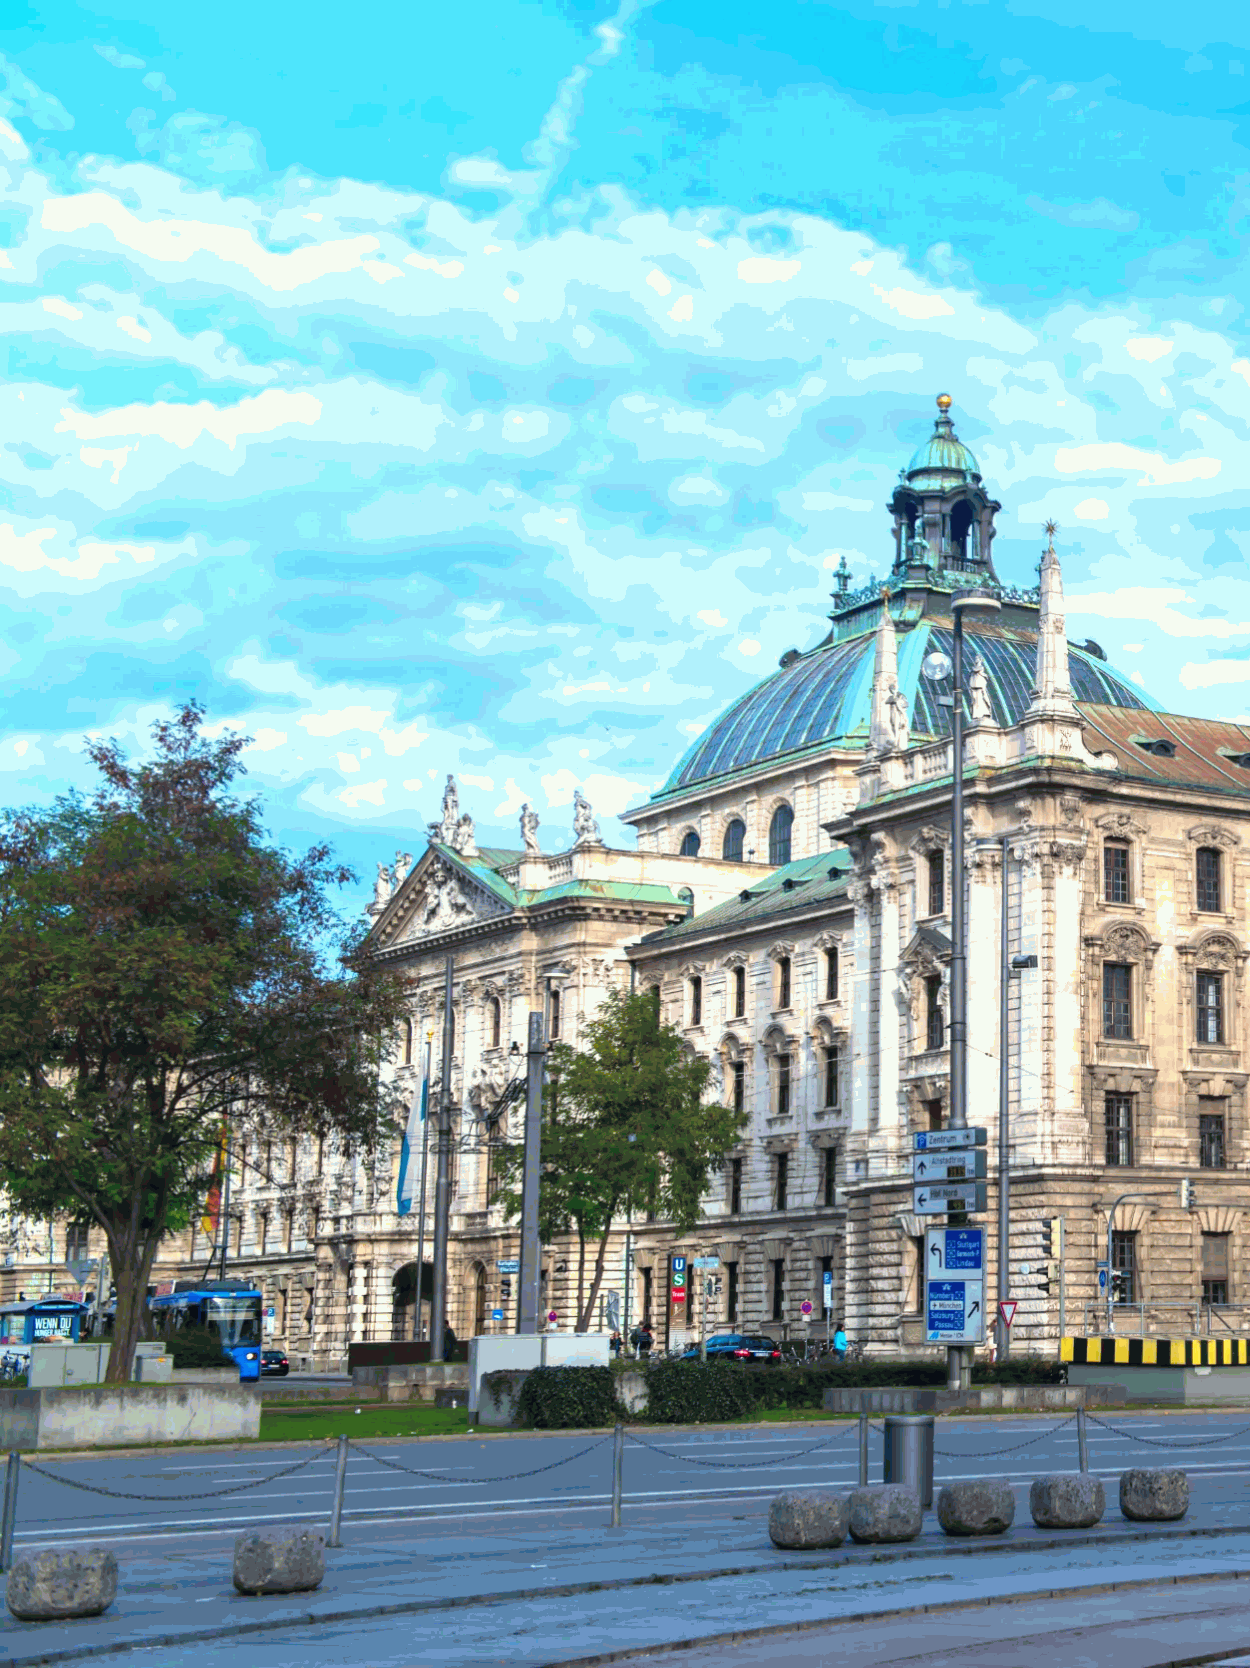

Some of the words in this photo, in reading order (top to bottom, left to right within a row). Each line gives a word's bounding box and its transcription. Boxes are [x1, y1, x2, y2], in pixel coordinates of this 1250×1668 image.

[929, 1134, 957, 1145] Zentrum
[943, 1189, 958, 1198] Nord
[957, 1241, 980, 1250] Stuttgart
[675, 1259, 684, 1270] U
[674, 1273, 684, 1286] S
[930, 1292, 954, 1301] Nürnberg
[931, 1311, 954, 1320] Salzburg
[35, 1317, 58, 1329] WENN
[60, 1317, 72, 1329] DU
